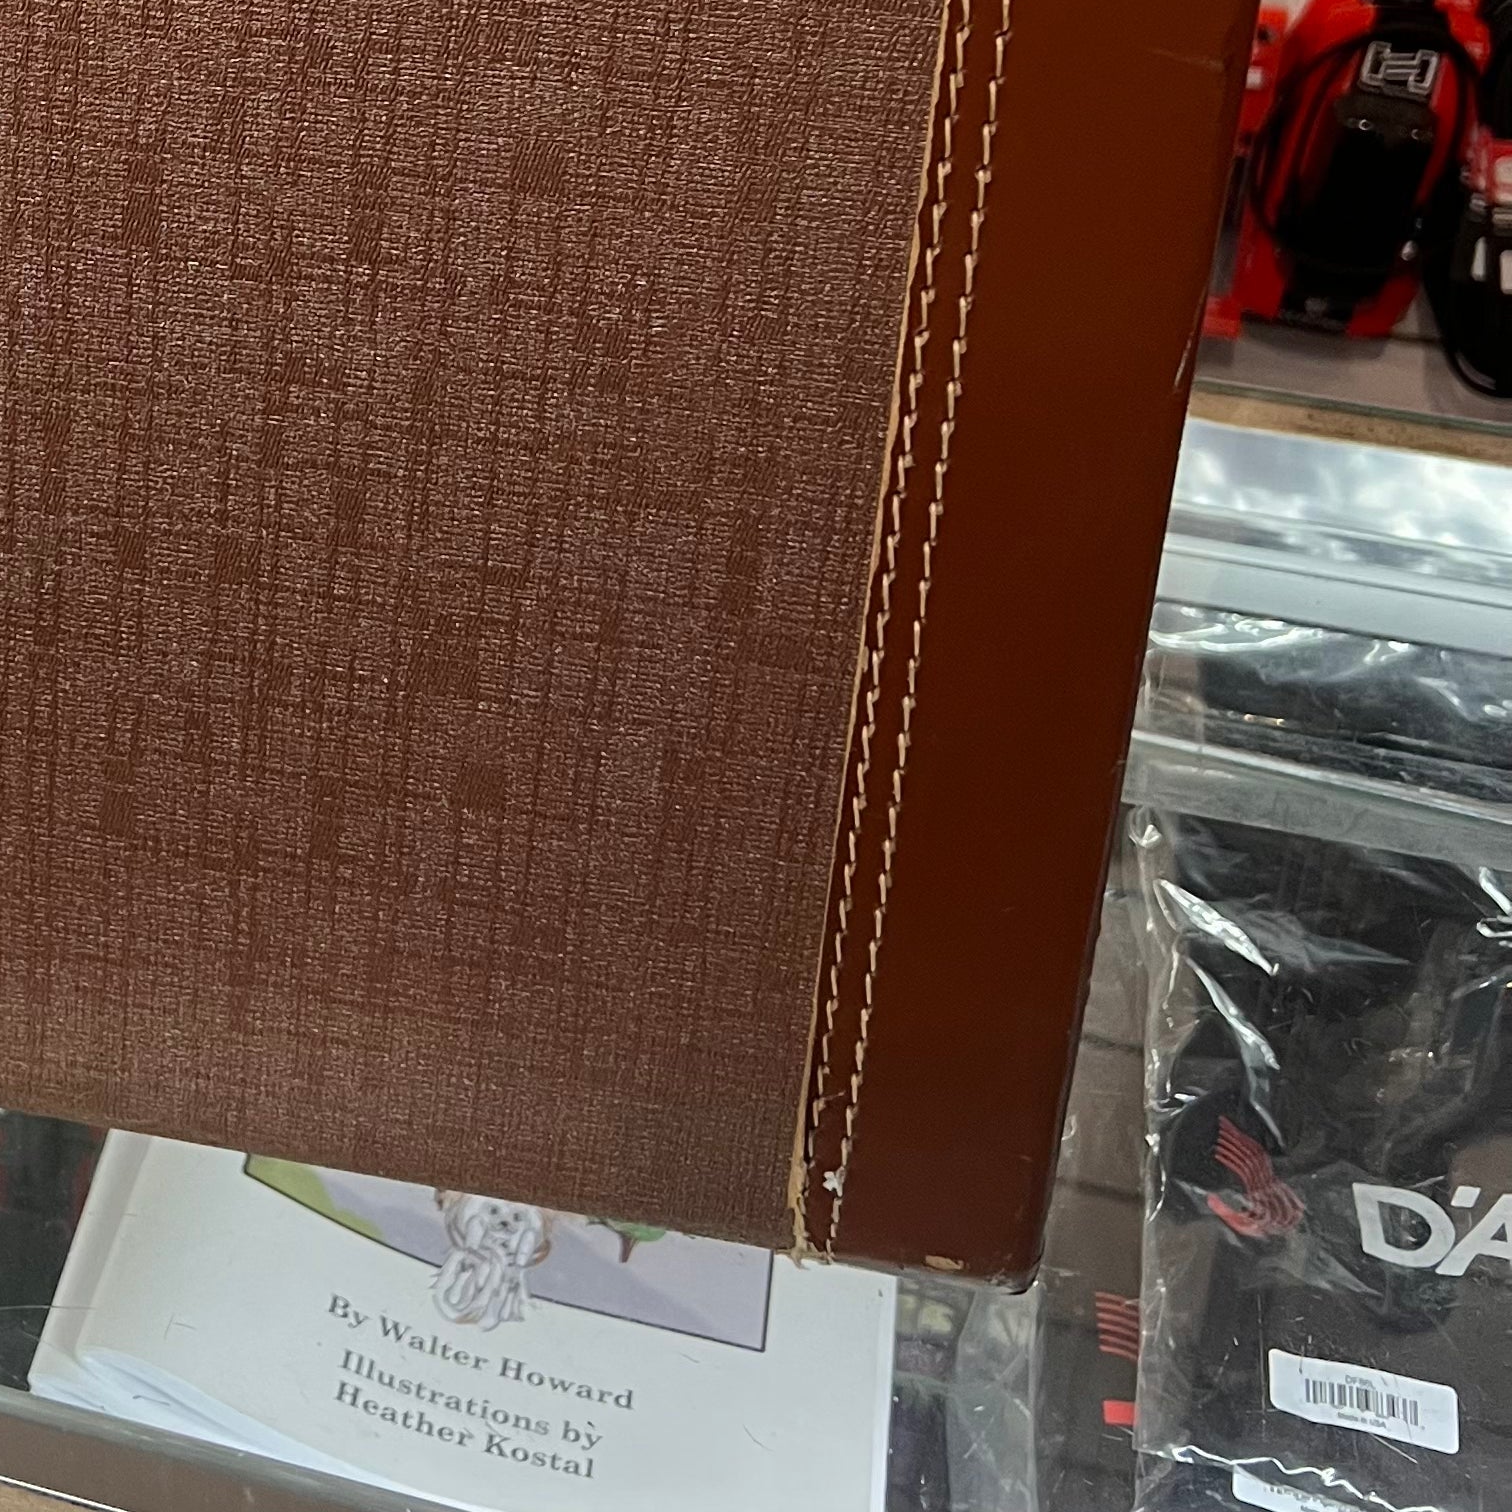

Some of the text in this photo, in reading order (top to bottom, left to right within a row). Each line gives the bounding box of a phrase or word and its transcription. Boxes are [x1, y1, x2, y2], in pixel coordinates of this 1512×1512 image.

[327, 1293, 636, 1412] By Walter Howard
[336, 1348, 604, 1452] Illustrations by
[334, 1381, 595, 1480] Heather Kostal
